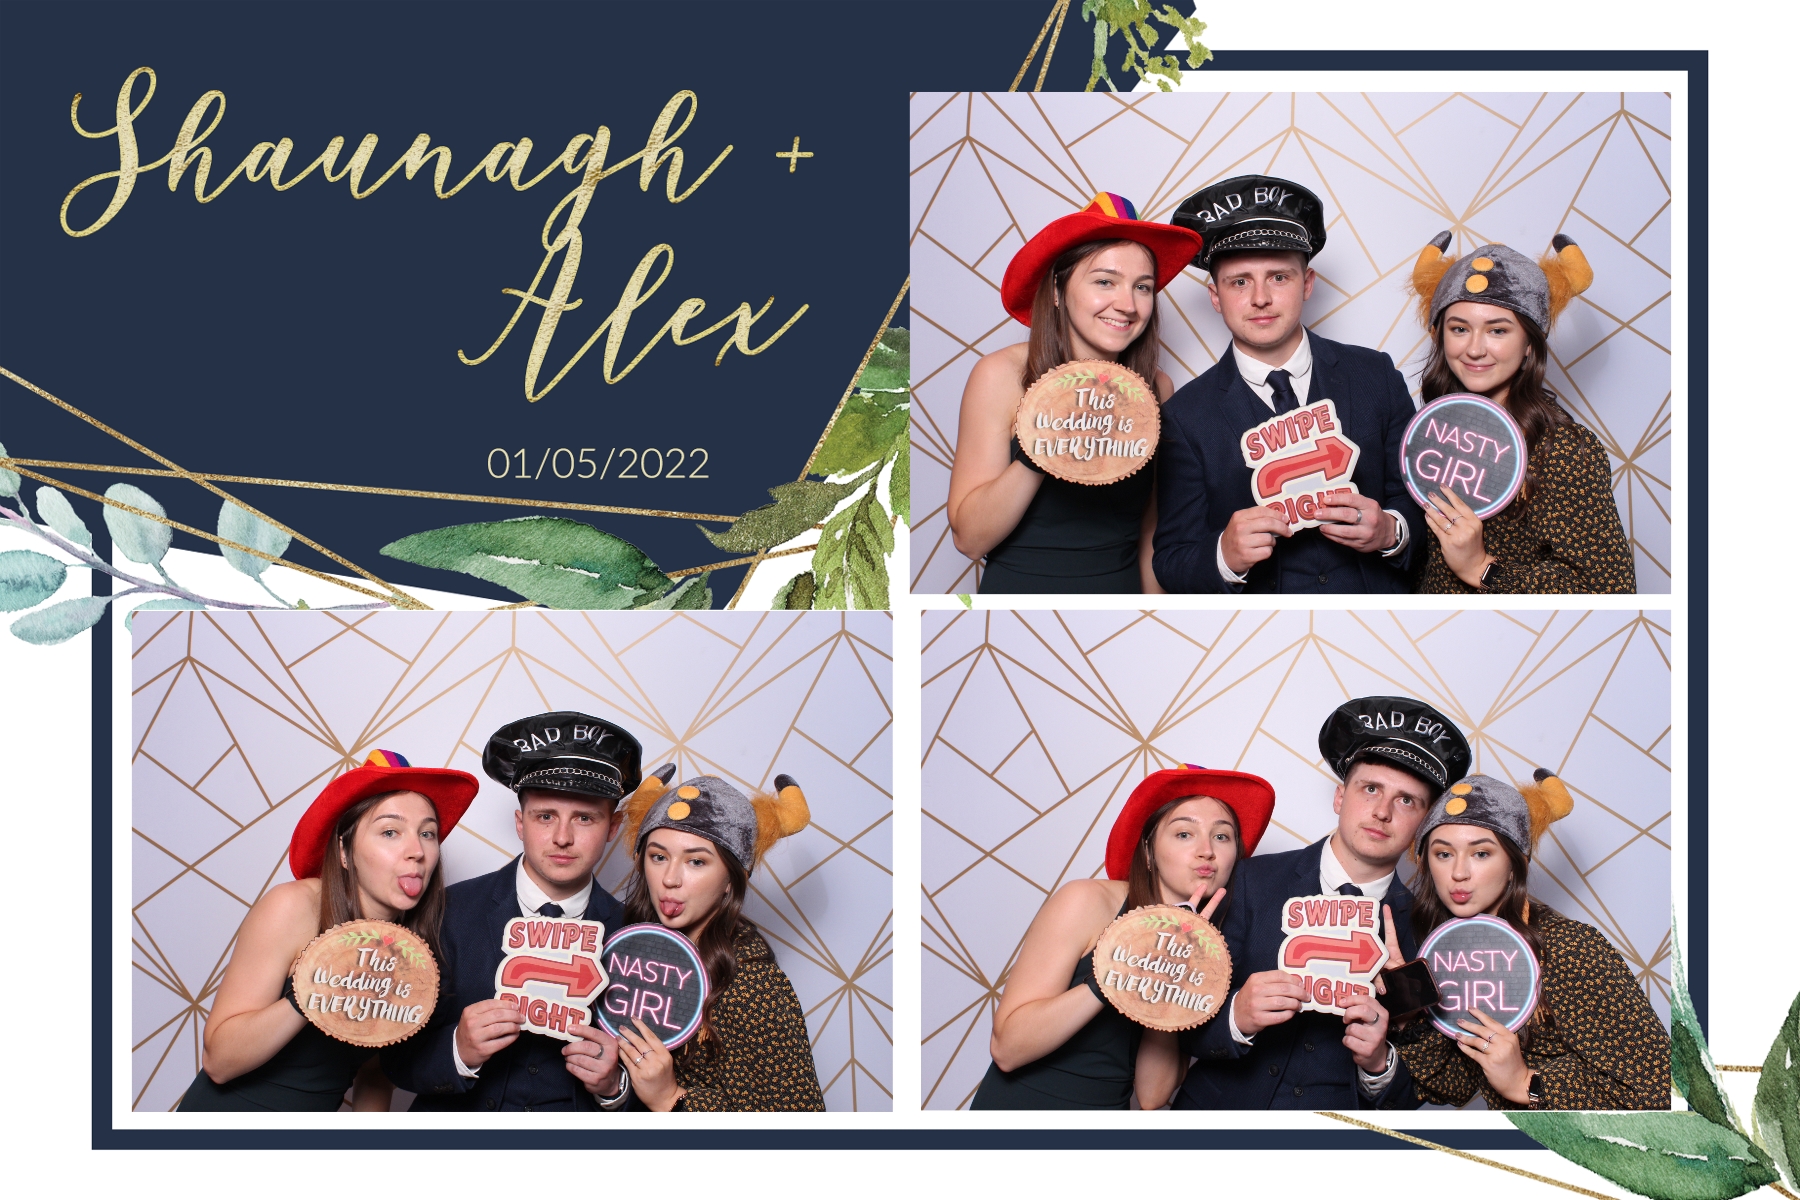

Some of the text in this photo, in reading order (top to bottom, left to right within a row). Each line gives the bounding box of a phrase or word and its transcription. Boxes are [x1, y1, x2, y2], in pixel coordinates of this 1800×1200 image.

[1196, 185, 1294, 223] BAD BOY
[1075, 387, 1117, 411] This
[1035, 409, 1135, 436] Wedding is
[1246, 404, 1335, 461] SWIPE
[1034, 435, 1149, 462] EVERYTHING
[1425, 418, 1511, 464] NASTY
[1416, 449, 1492, 503] GIRL
[513, 724, 614, 753] BAD BOY
[1414, 716, 1451, 744] BOY
[1288, 899, 1374, 929] SWIPE
[508, 921, 599, 953] SWIPE
[1157, 931, 1194, 959] This
[357, 947, 398, 972] This
[608, 952, 693, 990] NASTY
[1112, 944, 1206, 987] Wedding is
[1434, 949, 1518, 972] NASTY
[313, 964, 413, 999] Wedding is
[1104, 969, 1215, 1013] EVERYTHING
[1437, 980, 1520, 1011] GIRL
[308, 992, 424, 1024] EVERYTHING
[604, 983, 682, 1030] GIRL
